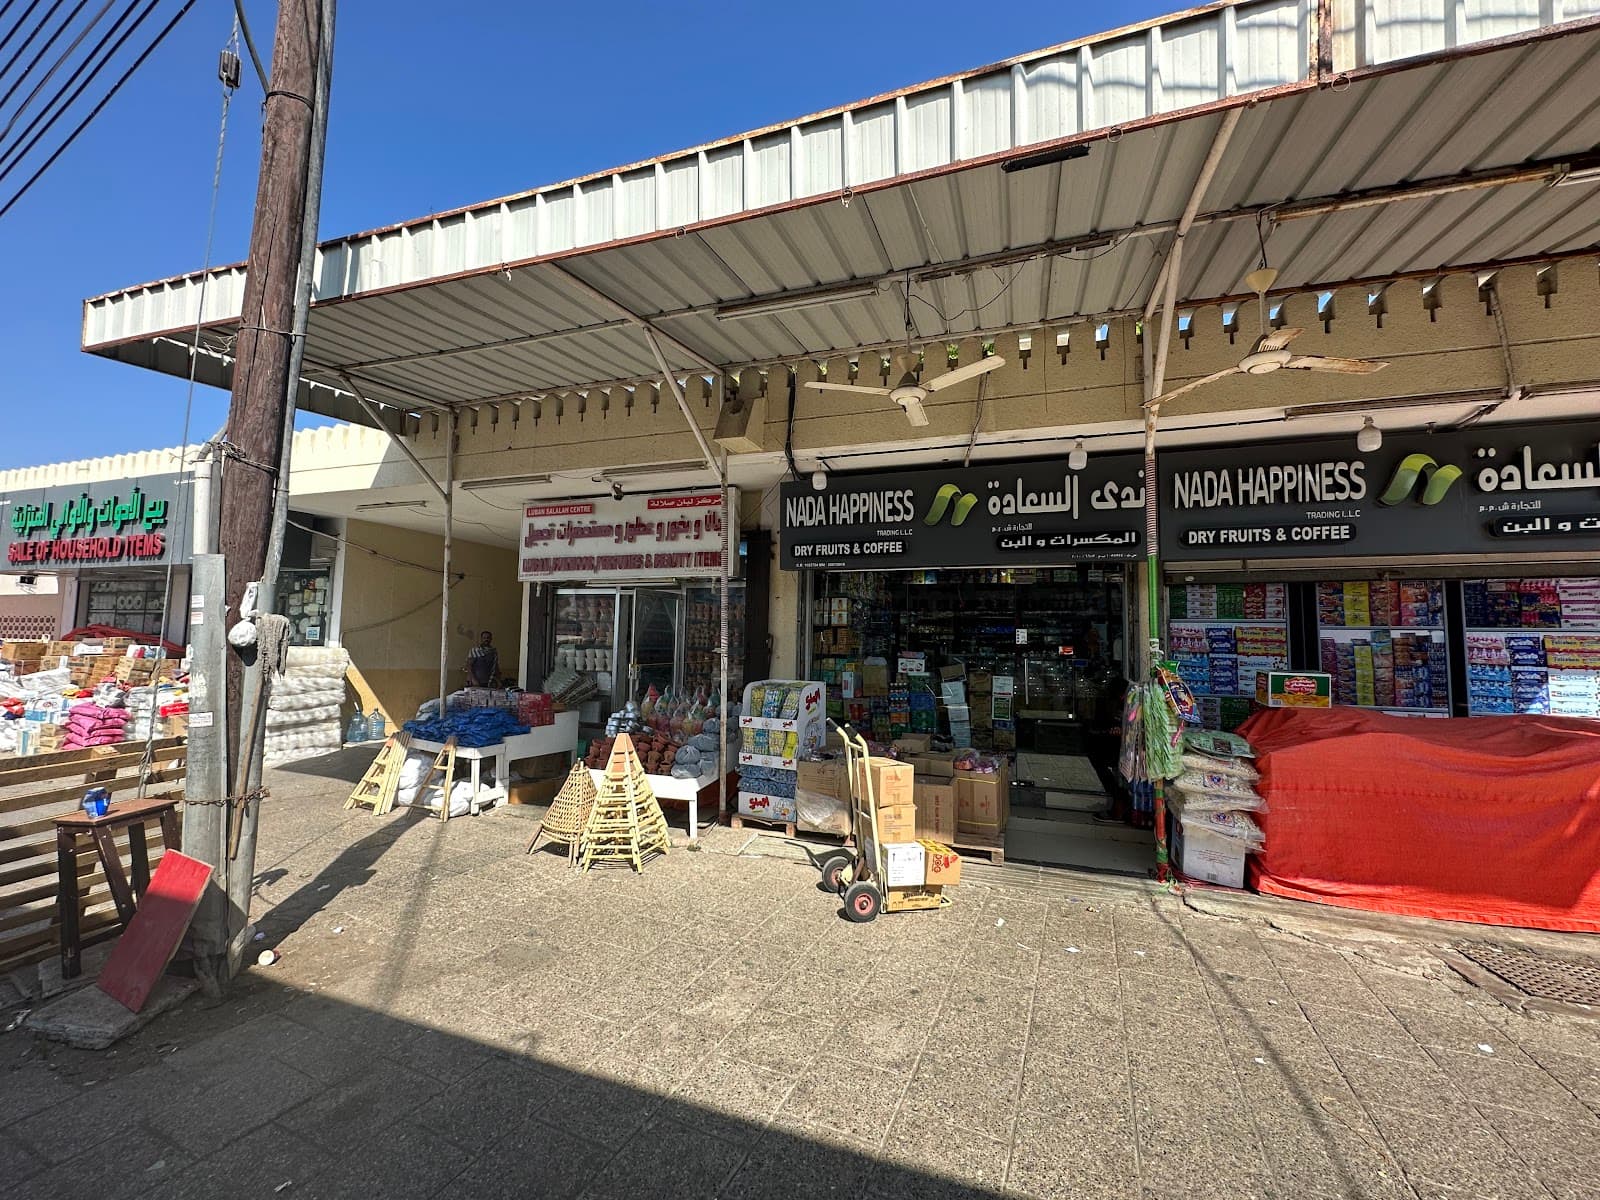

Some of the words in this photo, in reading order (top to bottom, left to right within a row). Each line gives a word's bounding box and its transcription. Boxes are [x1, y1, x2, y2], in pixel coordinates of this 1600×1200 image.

[1478, 441, 1600, 492] سعادة
[1091, 470, 1146, 510] ندى
[1174, 469, 1234, 509] NADA
[1238, 461, 1367, 506] HAPPINESS
[988, 475, 1079, 520] السعادة
[143, 499, 166, 530] بيع
[570, 504, 593, 513] CENTRE
[786, 496, 826, 528] NADA
[829, 489, 915, 525] HAPPINESS
[1306, 510, 1341, 519] TRADING
[1188, 530, 1216, 544] DRY
[1220, 528, 1272, 543] FRUITS
[1276, 527, 1287, 541] &
[1291, 525, 1350, 541] COFFEE
[1503, 518, 1551, 533] البن
[8, 541, 34, 563] SALE
[36, 540, 50, 561] OF
[51, 535, 122, 561] HOUSEHOLD
[125, 532, 163, 557] ITEMS
[794, 545, 814, 556] DRY
[815, 543, 851, 556] FRUITS
[853, 542, 861, 554] &
[863, 541, 903, 554] COFFEE
[1001, 536, 1032, 549] البن
[1036, 539, 1046, 548] و
[1050, 532, 1136, 547] المكسرات
